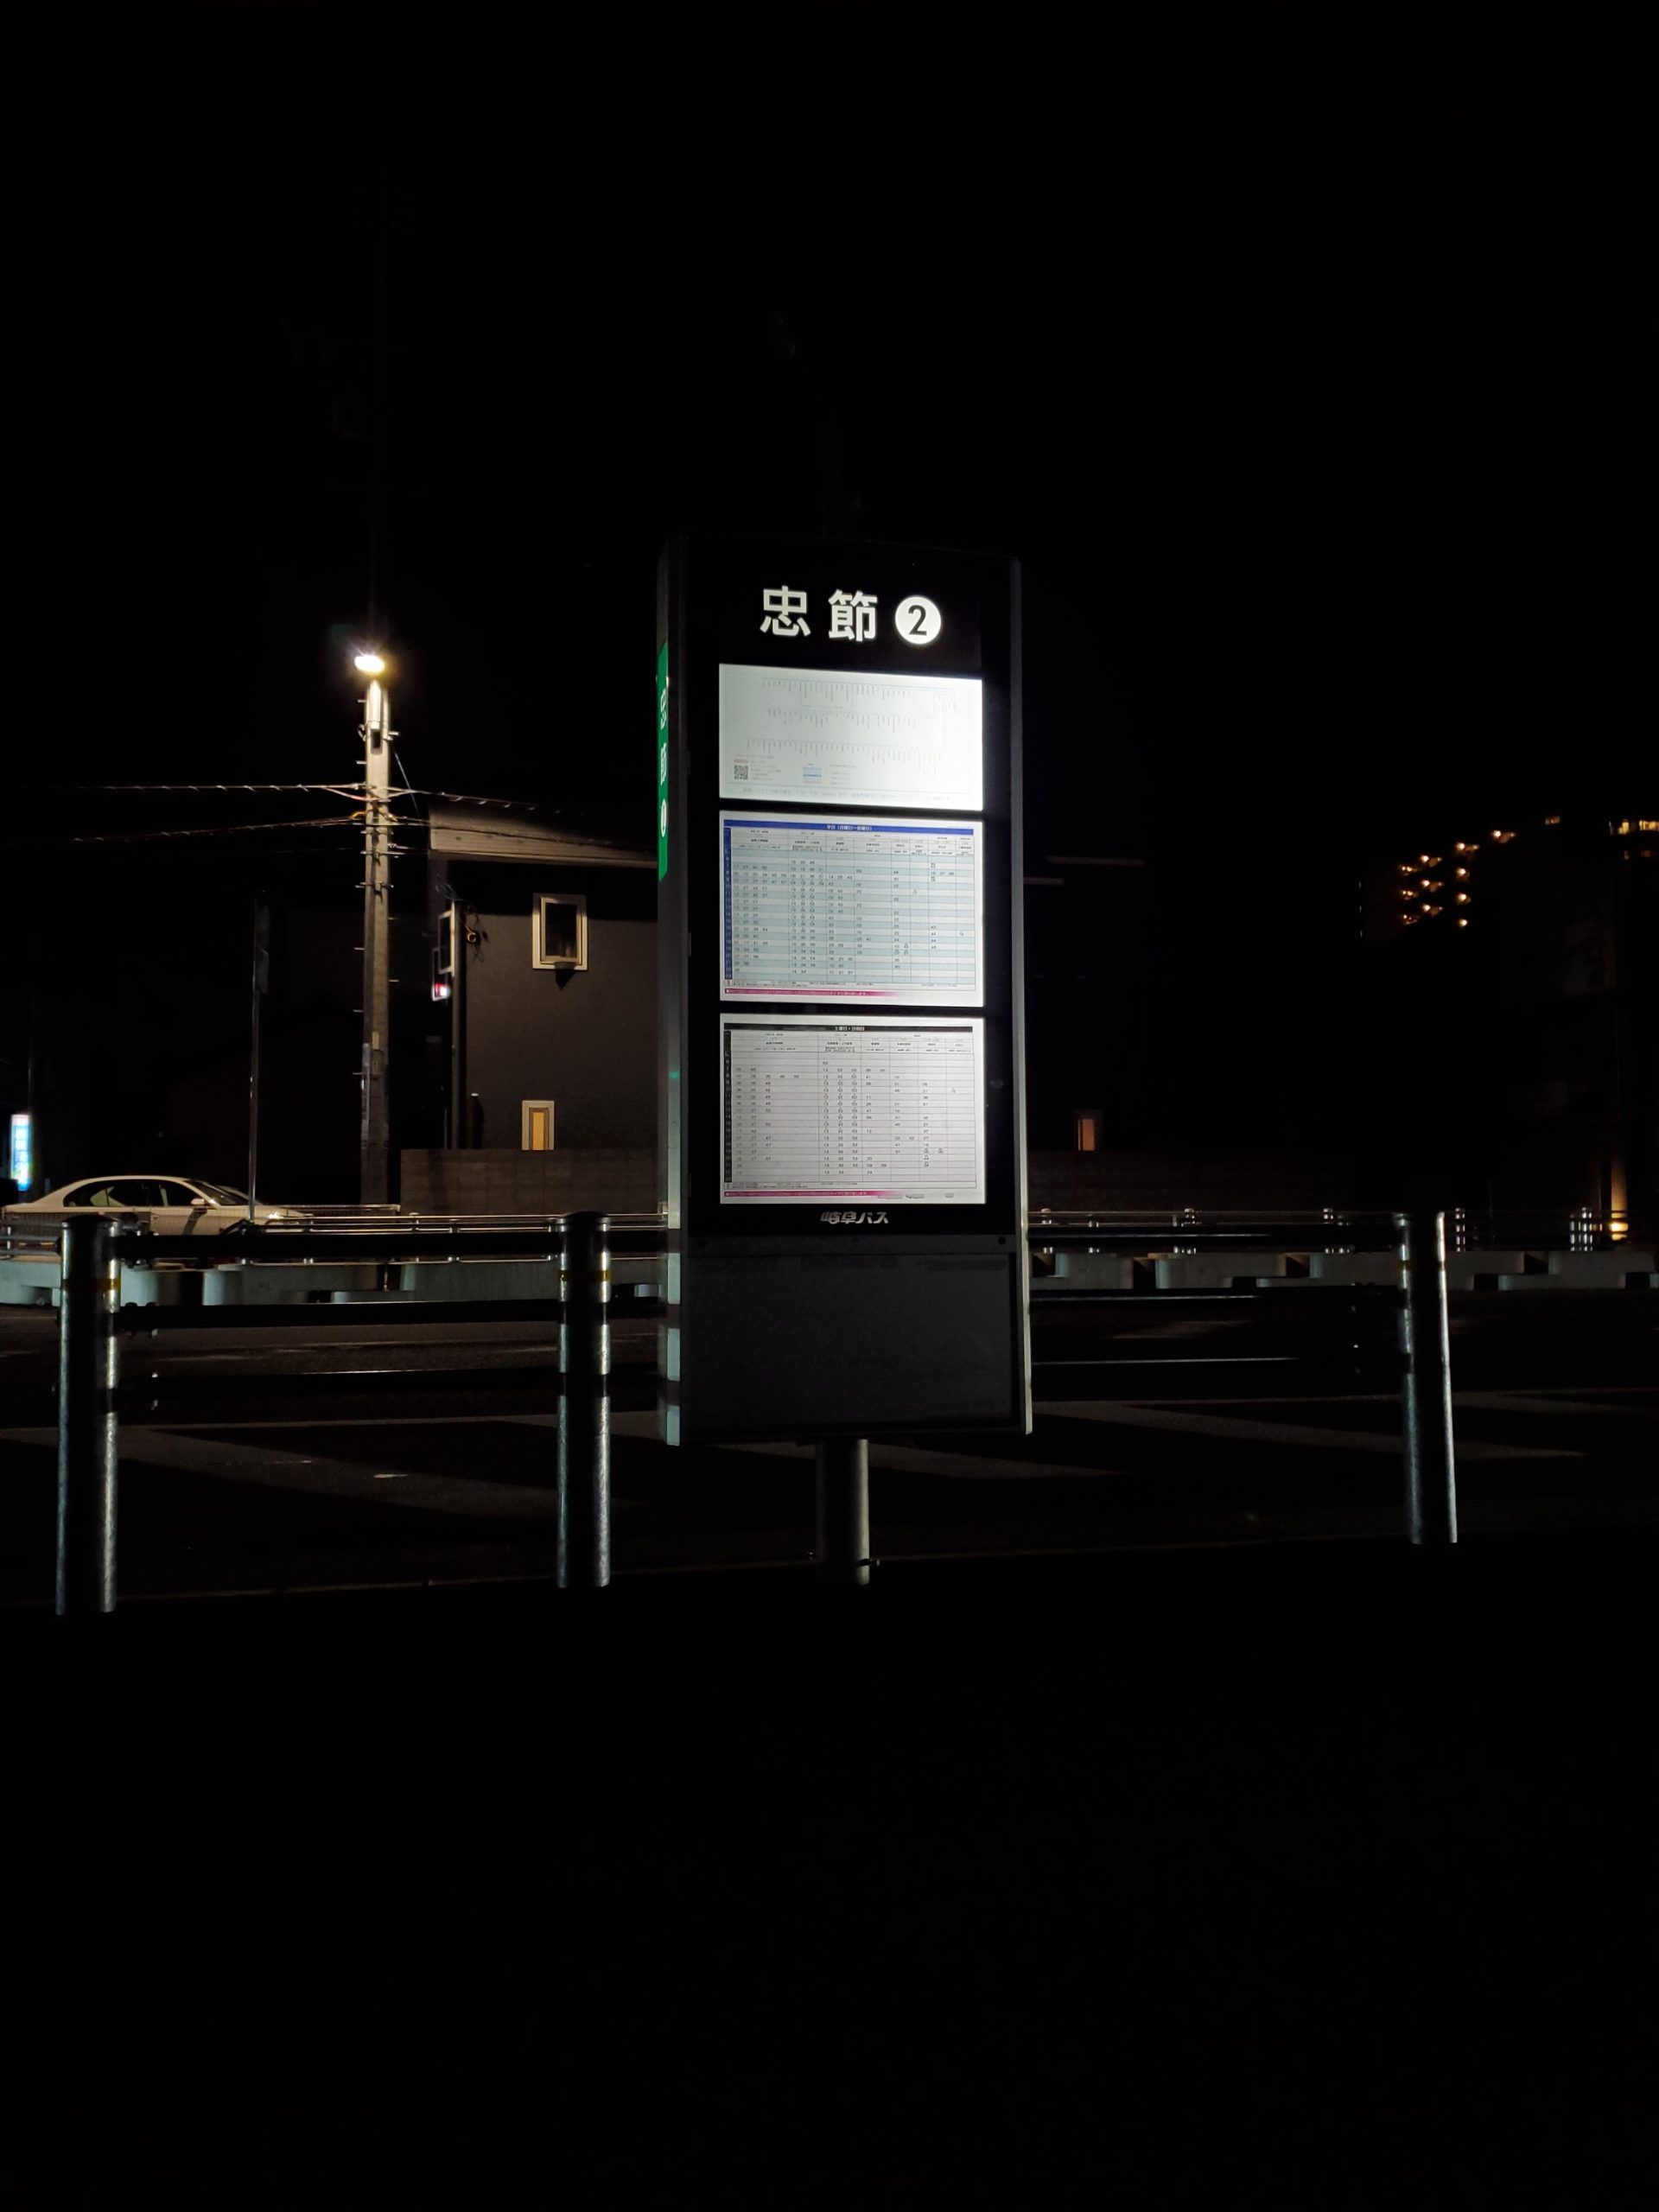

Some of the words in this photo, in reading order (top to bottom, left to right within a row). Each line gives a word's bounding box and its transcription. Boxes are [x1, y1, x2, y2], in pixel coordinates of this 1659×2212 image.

[760, 585, 879, 642] 忠節
[820, 1211, 889, 1224] 岐阜バス
